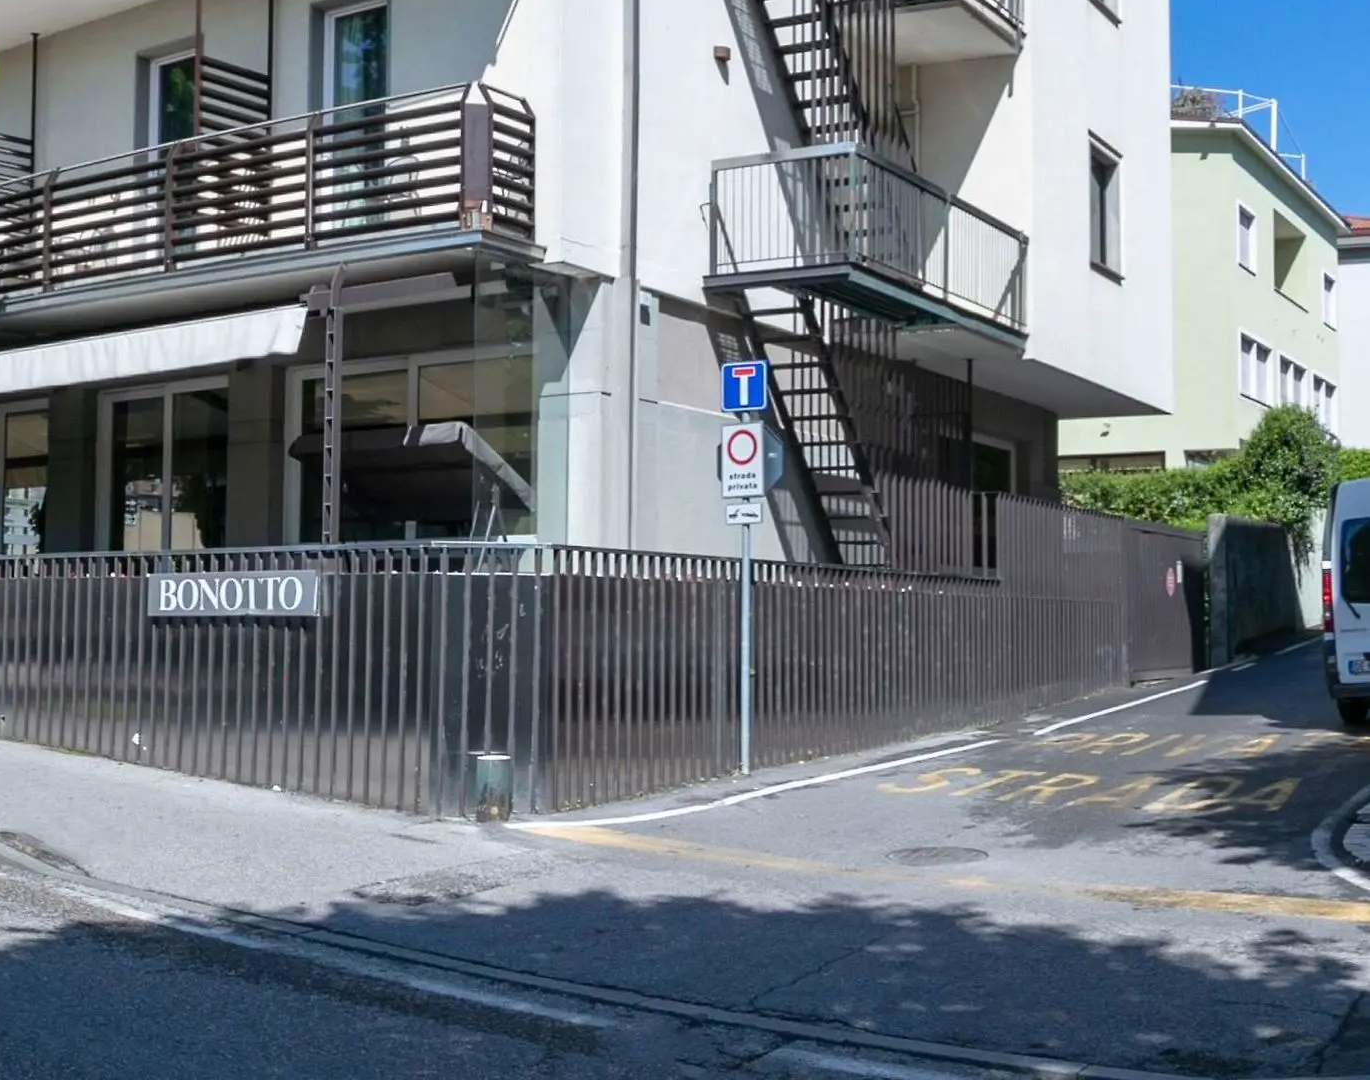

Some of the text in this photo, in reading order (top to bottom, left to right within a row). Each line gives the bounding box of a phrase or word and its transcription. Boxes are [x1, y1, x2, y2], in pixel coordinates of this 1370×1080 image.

[727, 482, 758, 492] privata
[729, 472, 756, 480] strada
[159, 576, 303, 611] BONOTTO
[877, 767, 1301, 811] STRADA
